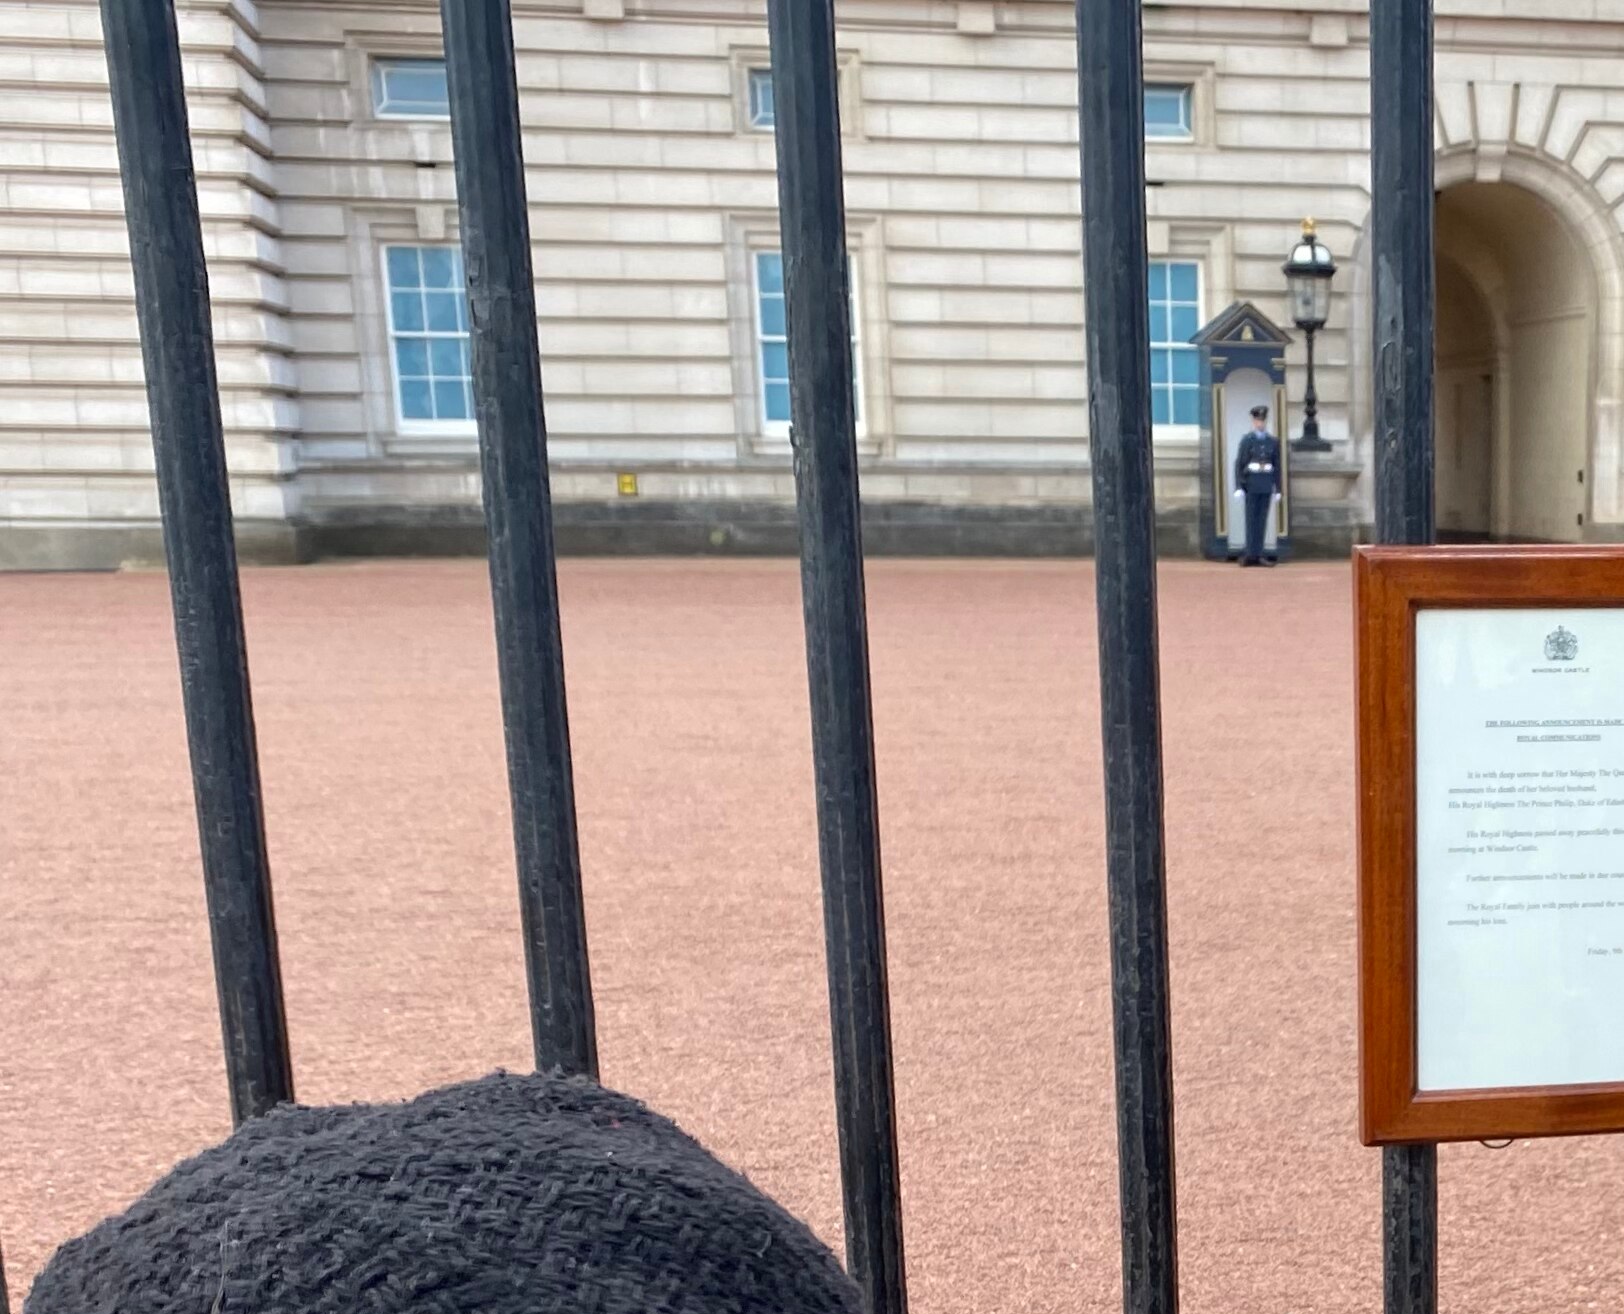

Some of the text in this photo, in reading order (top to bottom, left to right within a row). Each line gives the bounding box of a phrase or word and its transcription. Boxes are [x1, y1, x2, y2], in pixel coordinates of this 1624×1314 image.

[1499, 770, 1515, 780] deep
[1570, 770, 1596, 778] Majesty
[1462, 801, 1482, 810] Royal
[1484, 801, 1515, 809] Highness
[1480, 830, 1500, 839] Royal
[1502, 830, 1532, 839] Highness
[1534, 830, 1556, 838] passed
[1448, 846, 1476, 854] morning
[1481, 904, 1500, 912] Royal
[1503, 902, 1524, 910] Family
[1558, 901, 1579, 910] people
